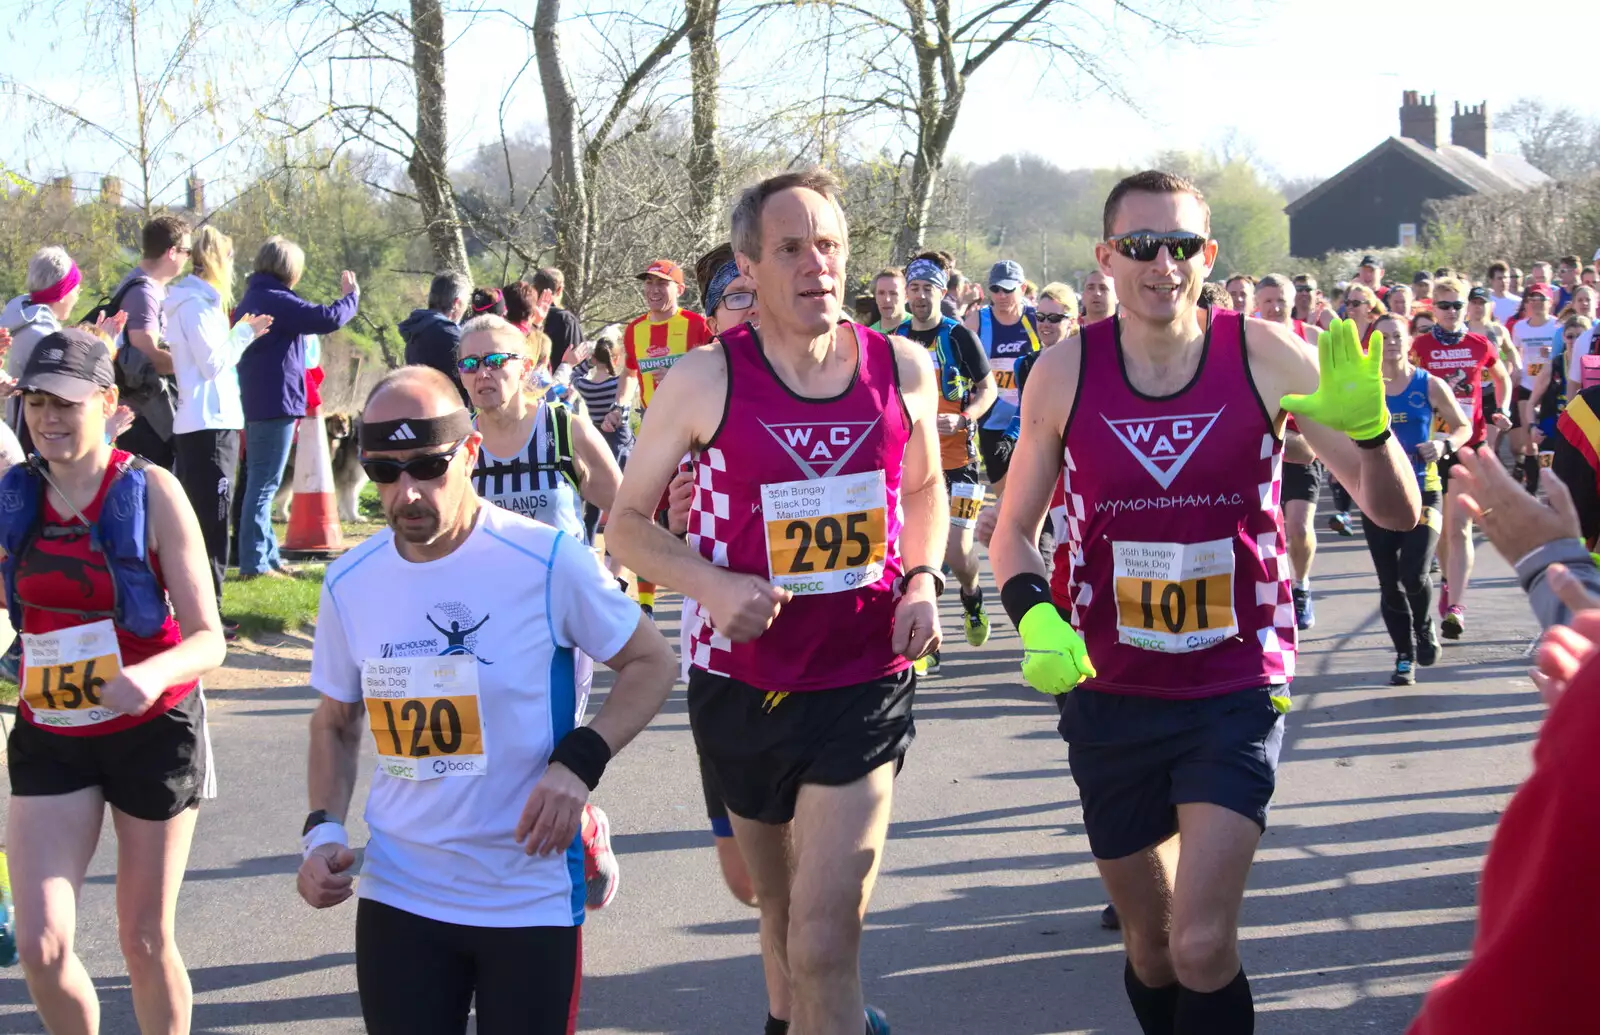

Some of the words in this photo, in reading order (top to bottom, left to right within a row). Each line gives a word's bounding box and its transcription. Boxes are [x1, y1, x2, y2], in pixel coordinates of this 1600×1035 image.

[769, 490, 789, 499] 35th
[792, 485, 826, 497] Bungay
[774, 501, 800, 510] Black
[802, 497, 822, 508] Dog
[1094, 494, 1211, 518] WYMONDHAM
[1214, 493, 1245, 506] A.C.
[776, 508, 821, 520] Marathon
[785, 512, 871, 573] 295
[1119, 547, 1140, 557] 35th
[1141, 548, 1176, 560] Bungay
[1125, 559, 1150, 568] Black
[1152, 559, 1171, 570] Dog
[1127, 568, 1169, 579] Marathon
[783, 581, 824, 593] NSPCC
[1141, 579, 1209, 634] 101
[394, 639, 438, 651] NICHOLSONS
[379, 664, 412, 675] Bungay
[42, 658, 107, 709] 156
[388, 677, 407, 688] Dog
[369, 689, 405, 698] Marathon
[382, 698, 462, 757] 120
